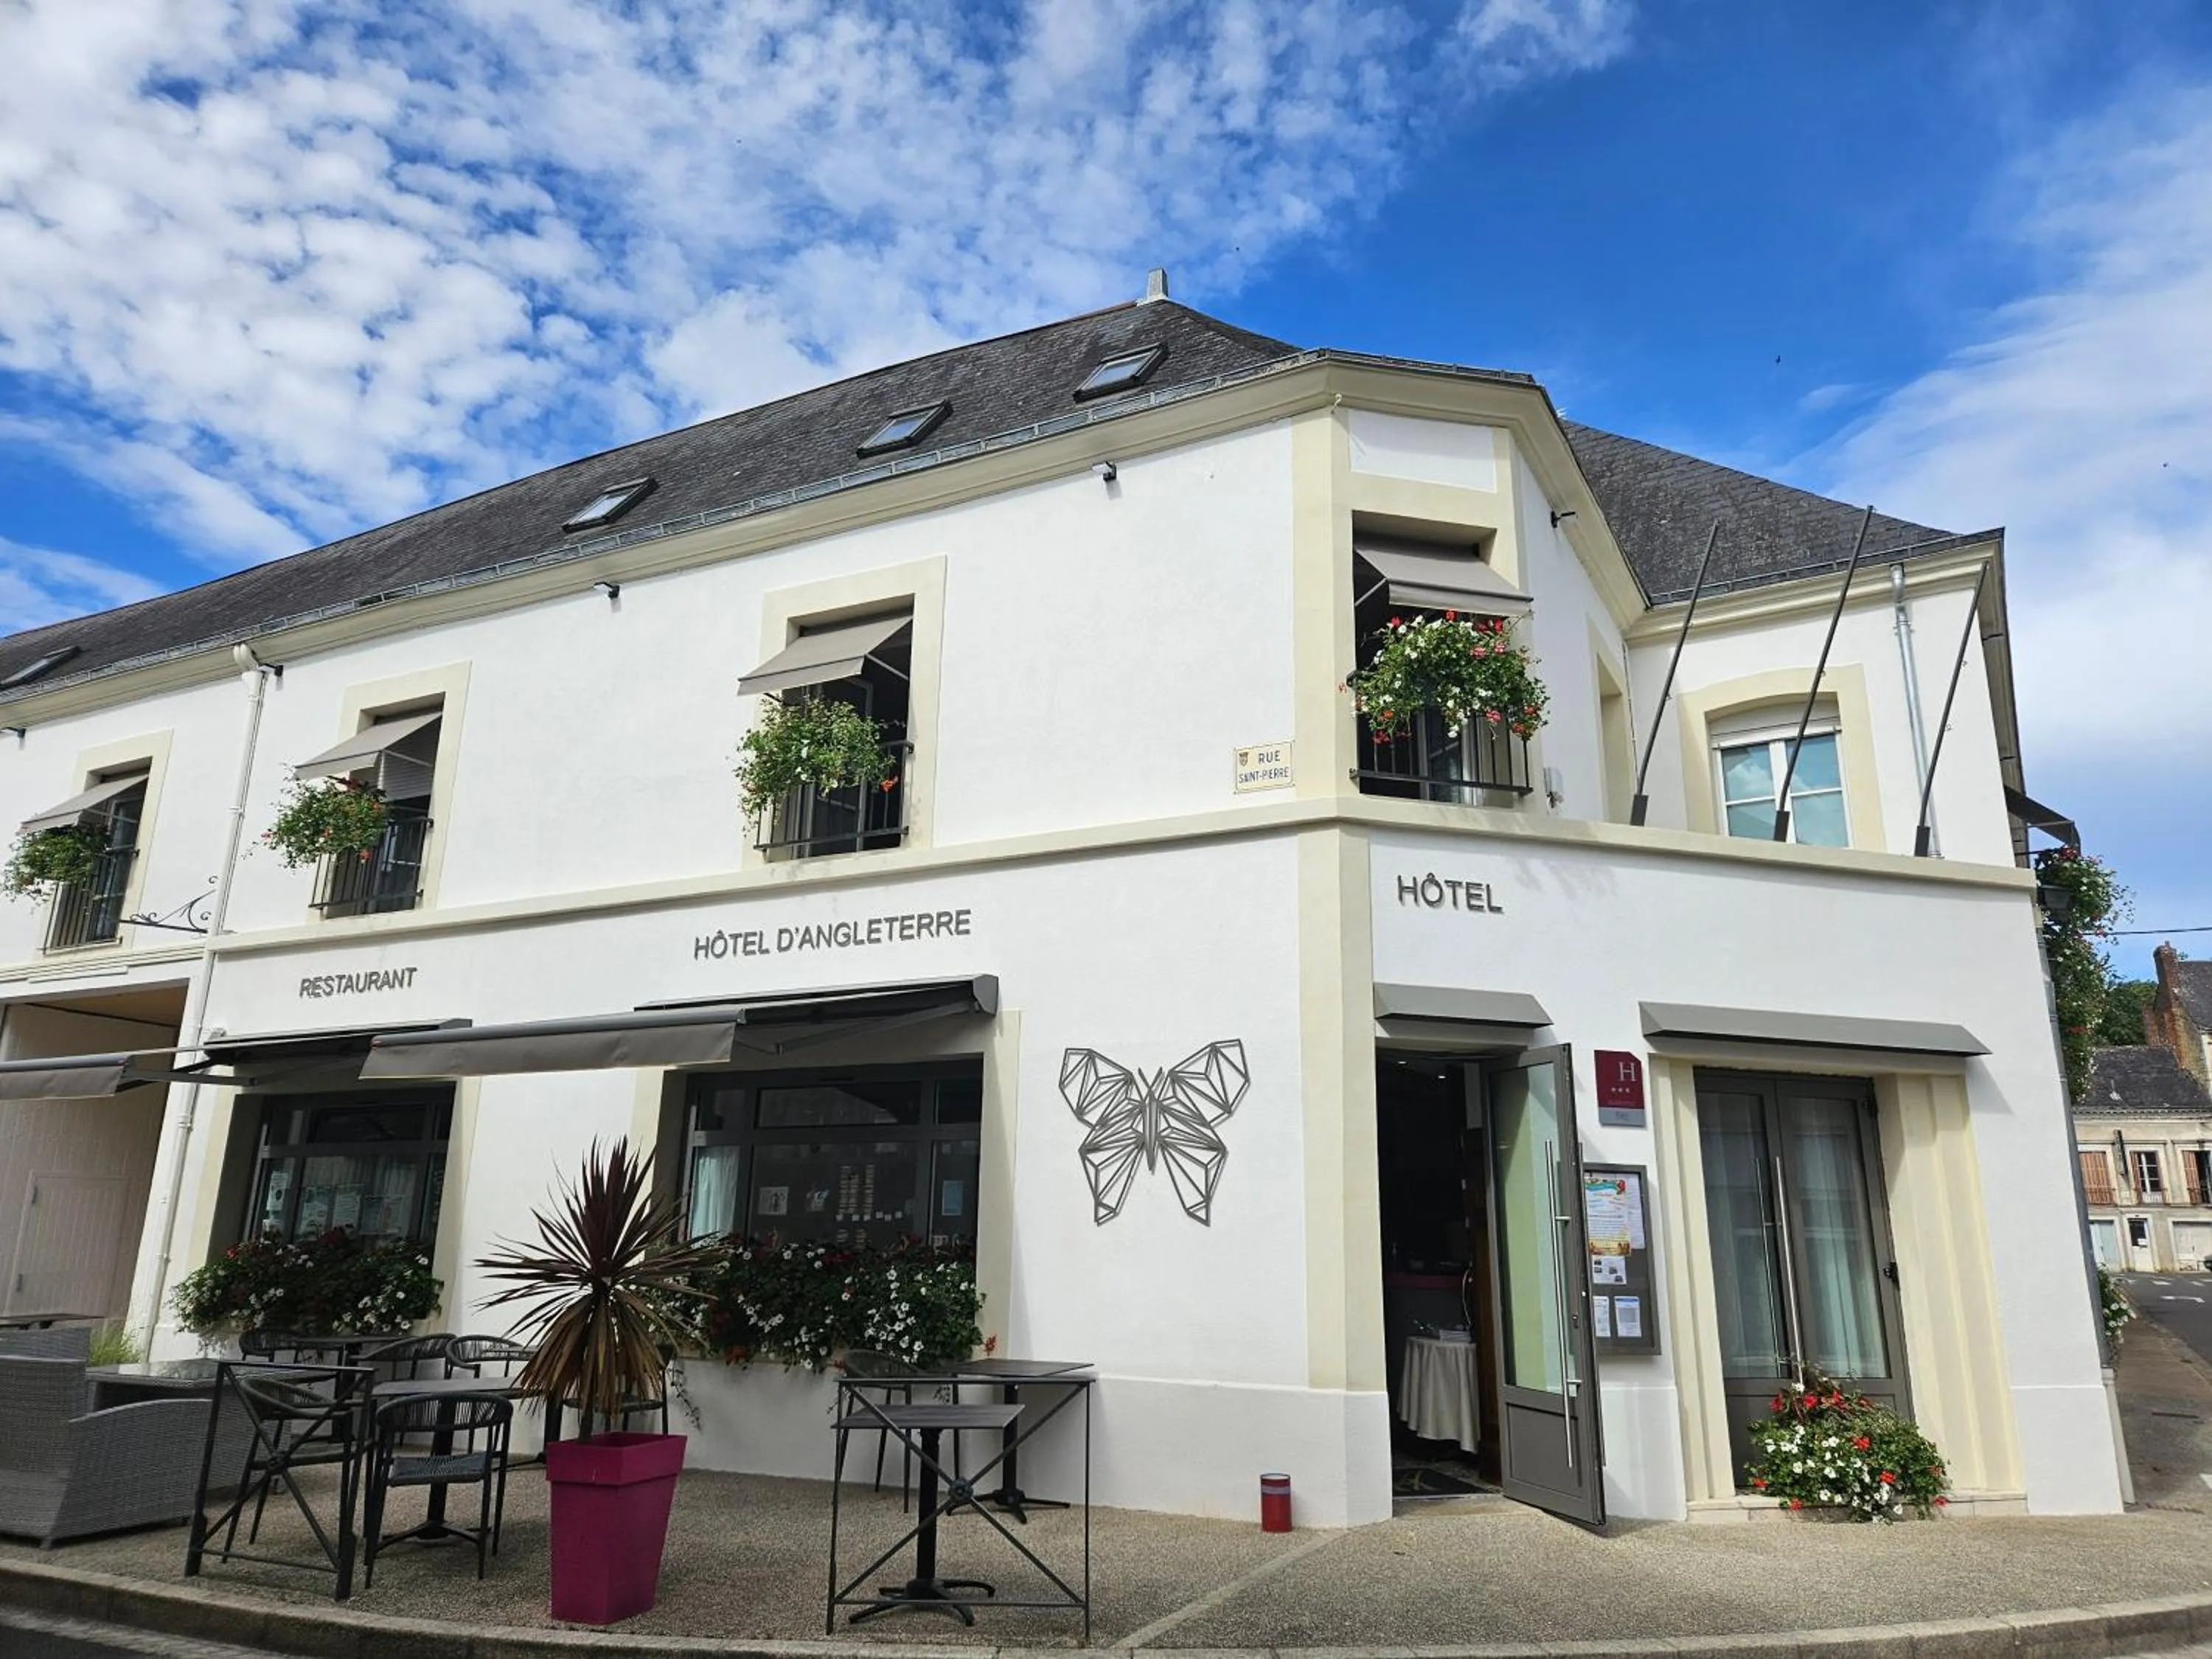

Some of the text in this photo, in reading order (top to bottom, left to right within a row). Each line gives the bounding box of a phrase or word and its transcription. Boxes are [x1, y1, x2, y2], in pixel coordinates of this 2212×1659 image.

[1258, 750, 1281, 764] RUE
[1238, 767, 1290, 784] SAINT-PIERRE
[1397, 872, 1503, 914] HÔTEL
[693, 908, 972, 961] HÔTEL D'ANGLETERRE
[299, 967, 418, 998] RESTAURANT
[1618, 1061, 1637, 1082] H
